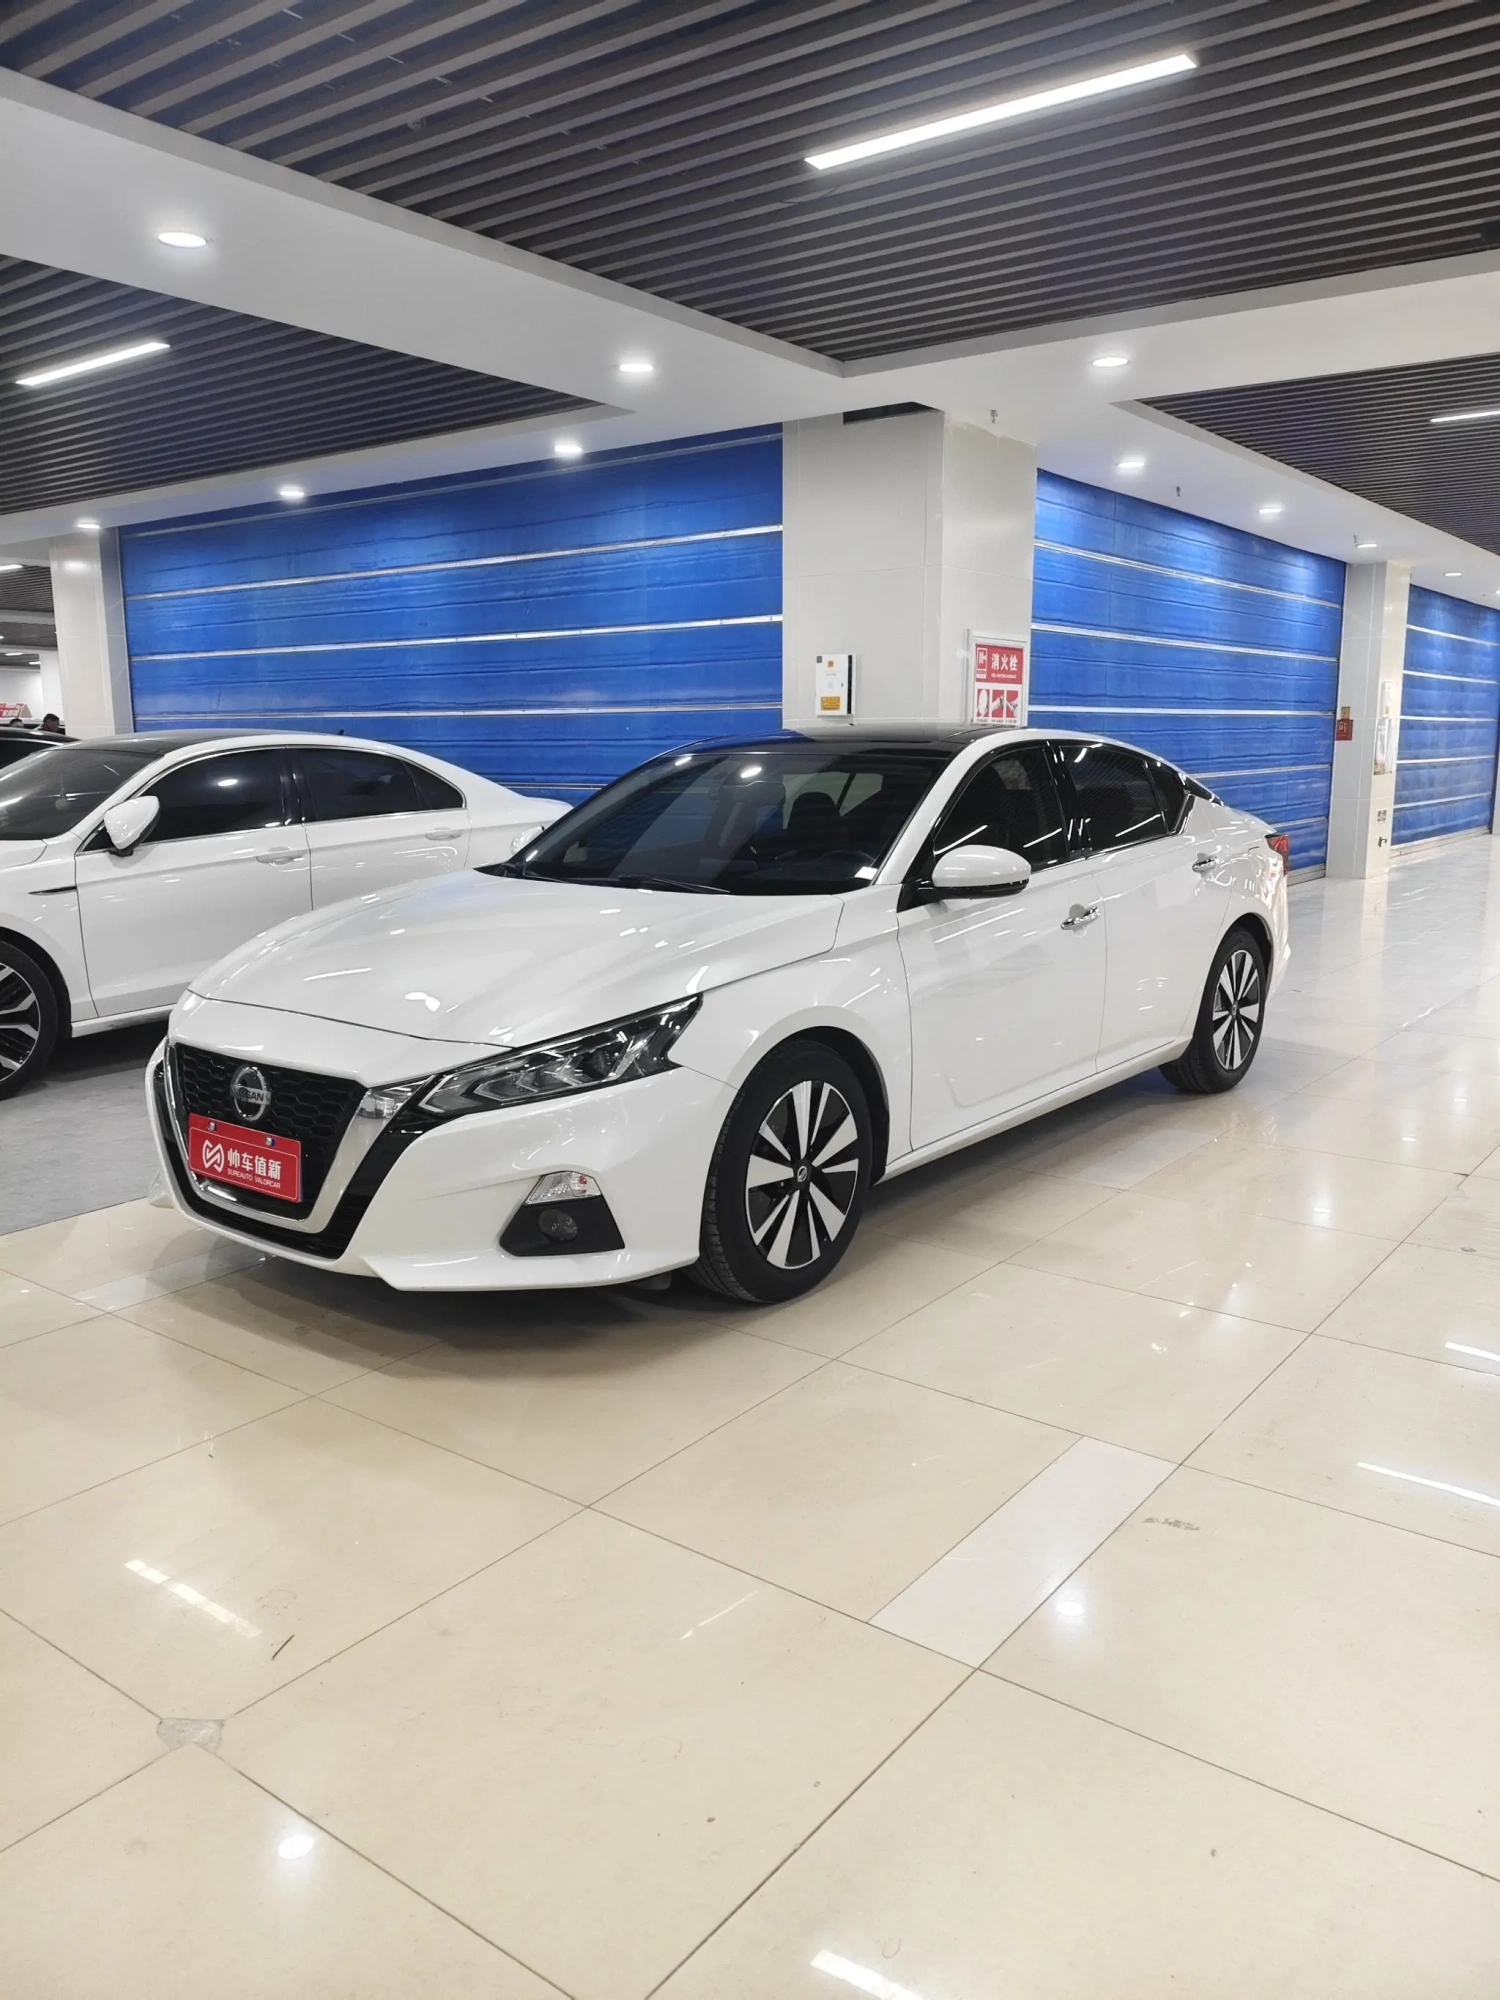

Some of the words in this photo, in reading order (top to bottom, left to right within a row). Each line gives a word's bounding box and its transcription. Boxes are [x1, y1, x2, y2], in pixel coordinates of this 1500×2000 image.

[991, 652, 1018, 671] 消火栓
[227, 1148, 282, 1180] 帅车值新
